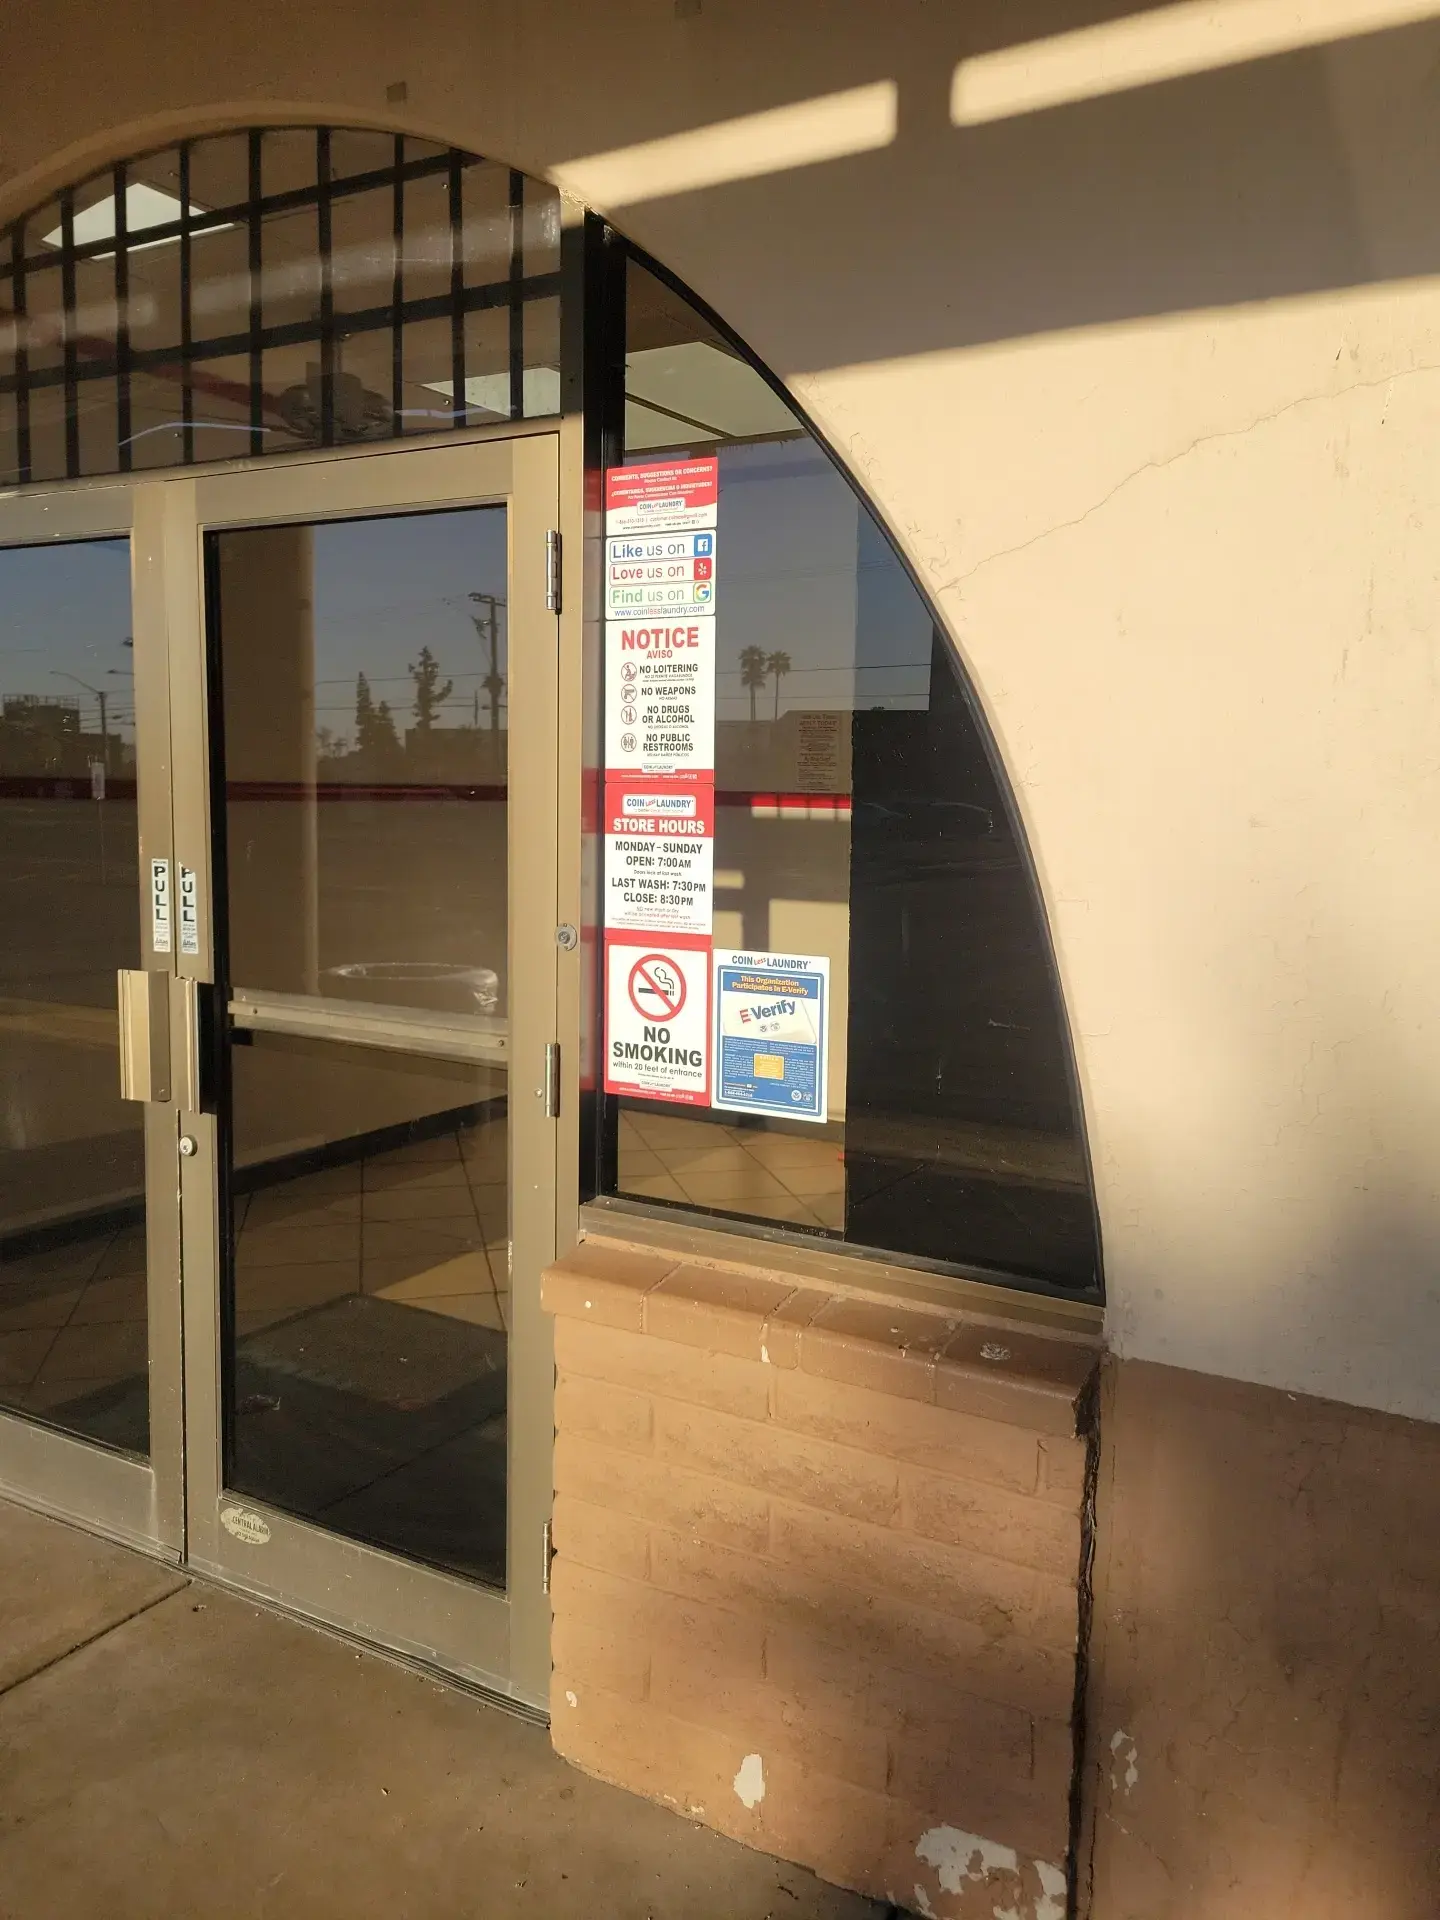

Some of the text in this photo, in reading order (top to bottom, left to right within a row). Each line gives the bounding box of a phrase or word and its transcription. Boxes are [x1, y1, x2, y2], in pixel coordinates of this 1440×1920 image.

[640, 470, 674, 479] SUGGESTIONS
[683, 466, 712, 475] CONCERNS?
[639, 502, 651, 510] COIN
[612, 545, 643, 559] Like
[647, 545, 663, 556] us
[667, 543, 685, 555] on
[612, 565, 685, 580] Love us on
[612, 588, 643, 603] Find
[647, 590, 663, 602] us
[667, 589, 684, 600] on
[615, 604, 705, 617] www.coinlesslaundry.com
[621, 626, 699, 651] NOTICE
[646, 649, 673, 659] AVISO
[639, 663, 698, 674] NO LOITERING
[641, 686, 696, 696] NO WEAPONS
[647, 705, 690, 714] NO DRUGS
[642, 714, 695, 723] OR ALCOHOL
[646, 733, 690, 742] NO PUBLIC
[643, 743, 694, 752] RESTROOMS
[626, 798, 645, 807] COIN
[656, 799, 692, 809] LAUNDRY
[613, 818, 705, 834] STORE HOURS
[615, 841, 655, 852] MONDAY
[663, 842, 703, 854] SUNDAY
[626, 856, 655, 867] OPEN:
[611, 877, 636, 888] LAST
[638, 878, 670, 890] WASH:
[154, 866, 167, 921] PULL
[623, 892, 657, 904] CLOSE:
[732, 955, 753, 966] COIN
[766, 957, 809, 970] LAUNDRY
[740, 975, 799, 987] This Organization
[732, 982, 773, 992] Participates
[781, 986, 809, 996] E-Verify
[643, 1025, 671, 1045] NO
[613, 1041, 703, 1067] SMOKING
[613, 1060, 633, 1070] within
[634, 1062, 643, 1071] 20
[645, 1063, 659, 1072] feet
[660, 1064, 668, 1074] of
[669, 1067, 703, 1078] entrance
[232, 1515, 252, 1530] CENTRAL
